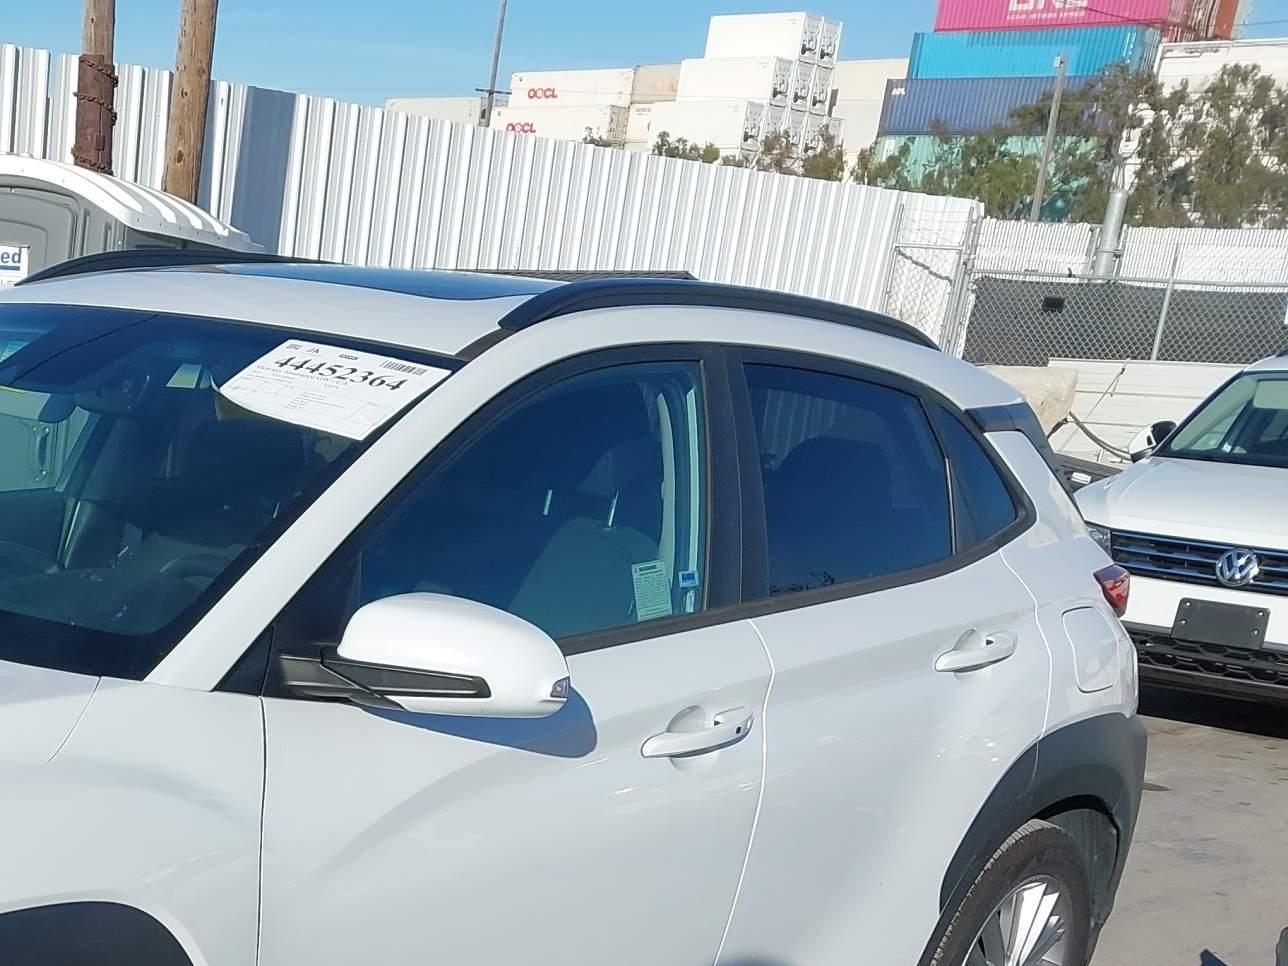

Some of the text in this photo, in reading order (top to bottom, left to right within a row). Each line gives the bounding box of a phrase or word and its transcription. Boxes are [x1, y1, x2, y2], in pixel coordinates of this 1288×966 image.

[527, 88, 558, 100] OOCL
[506, 122, 537, 134] OOCL
[274, 355, 409, 391] 44452364
